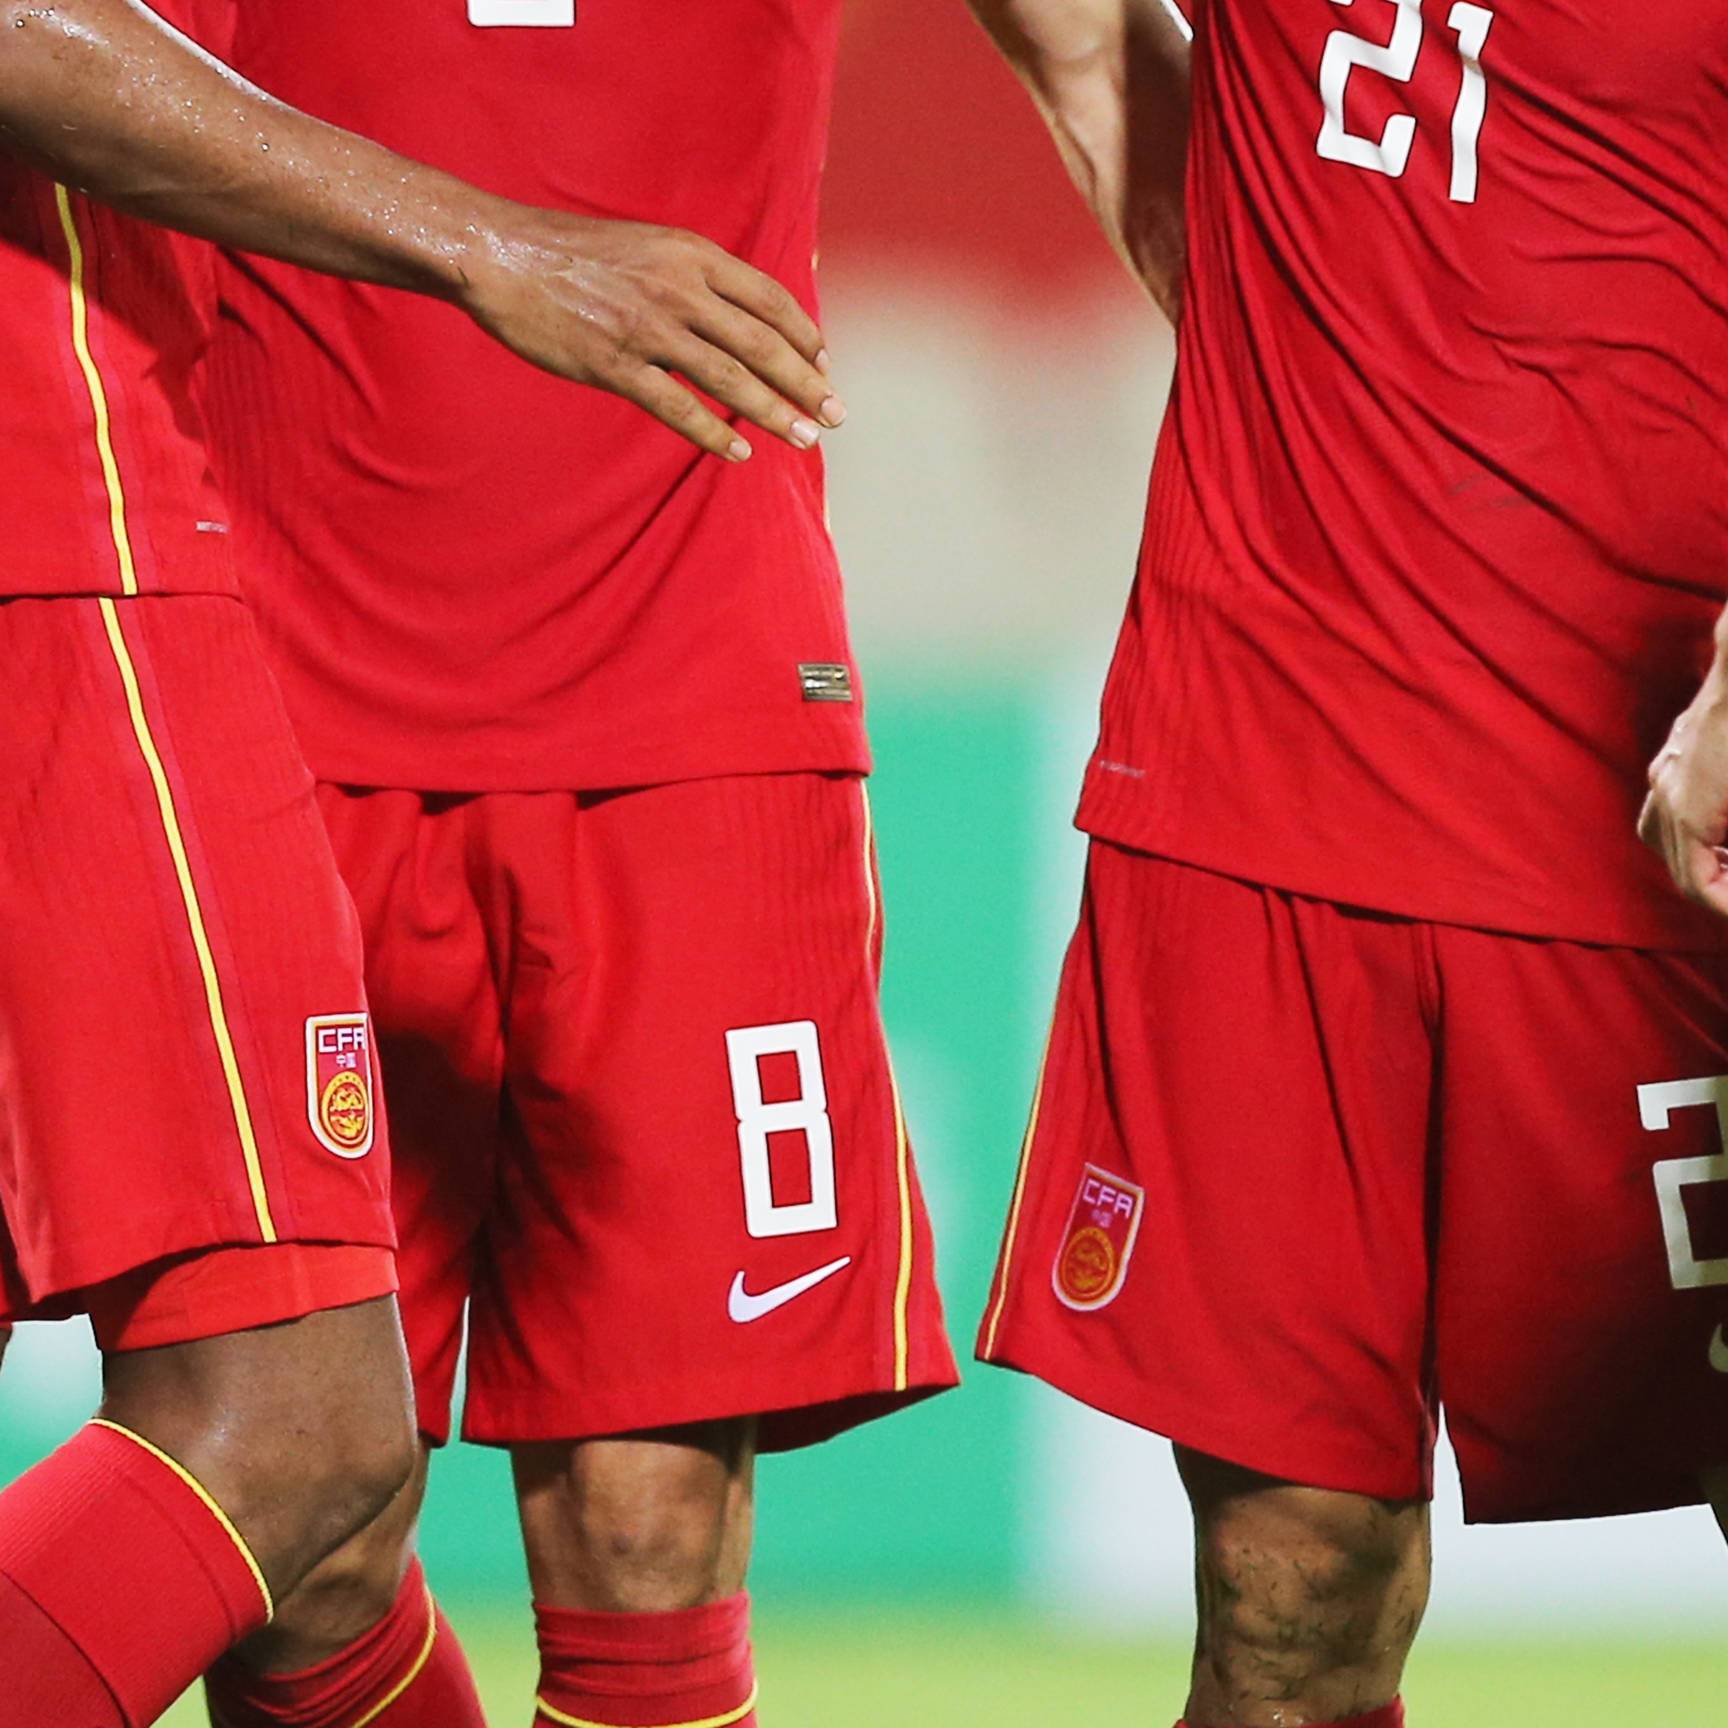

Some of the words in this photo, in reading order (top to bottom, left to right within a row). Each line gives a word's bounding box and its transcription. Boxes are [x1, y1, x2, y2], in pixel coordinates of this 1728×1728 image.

[317, 1027, 366, 1053] CFA
[726, 1020, 838, 1238] 8
[1081, 1178, 1135, 1219] CFA
